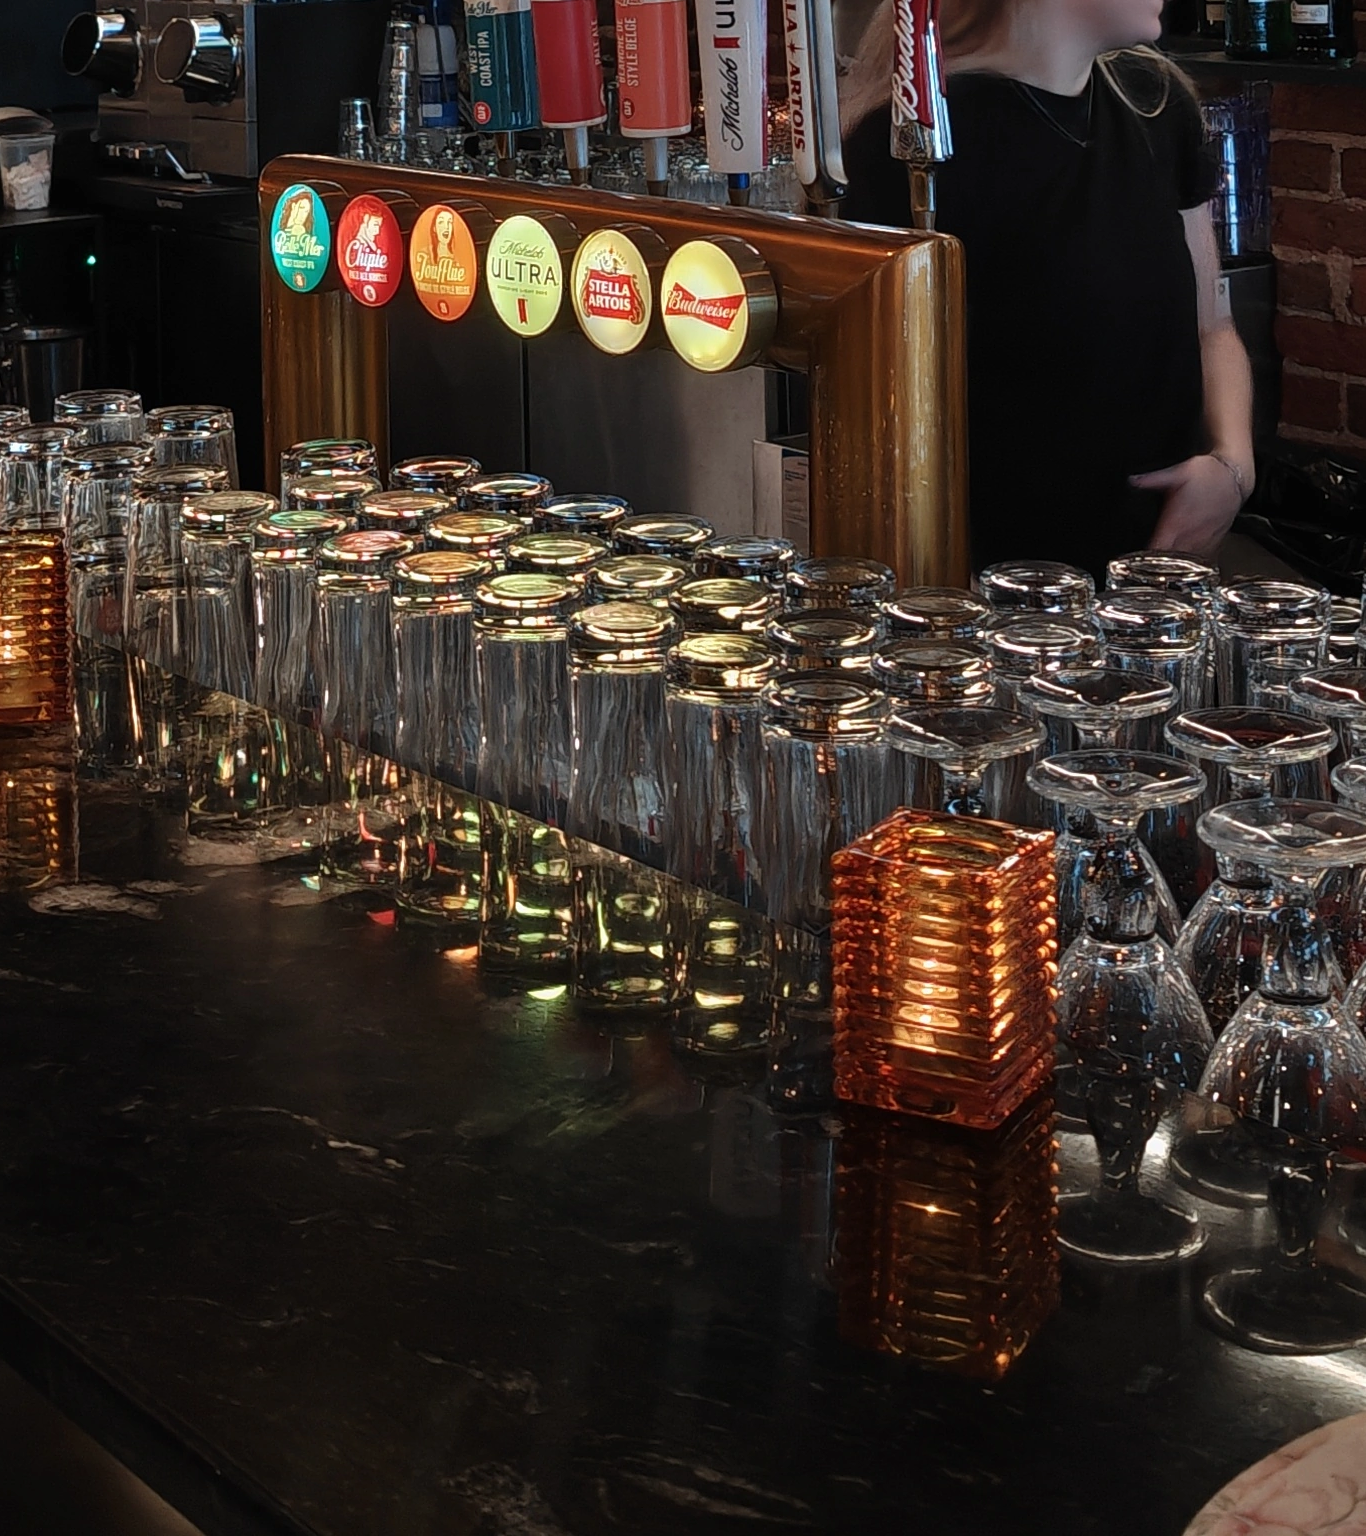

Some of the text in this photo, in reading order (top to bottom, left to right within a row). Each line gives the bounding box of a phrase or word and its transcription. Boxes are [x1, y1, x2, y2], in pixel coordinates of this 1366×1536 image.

[477, 30, 490, 48] IPA
[624, 17, 637, 51] BELGE
[468, 43, 479, 74] WEST
[478, 50, 493, 87] COAST
[626, 52, 639, 86] STYLE
[721, 53, 744, 151] Michelob
[789, 64, 806, 152] ARTOIS
[345, 240, 388, 272] Chipie
[499, 239, 546, 259] Michelob
[491, 256, 558, 287] ULTRA
[588, 278, 631, 297] STELLA
[588, 293, 632, 311] ARTOIS
[667, 290, 738, 320] Budweiser
